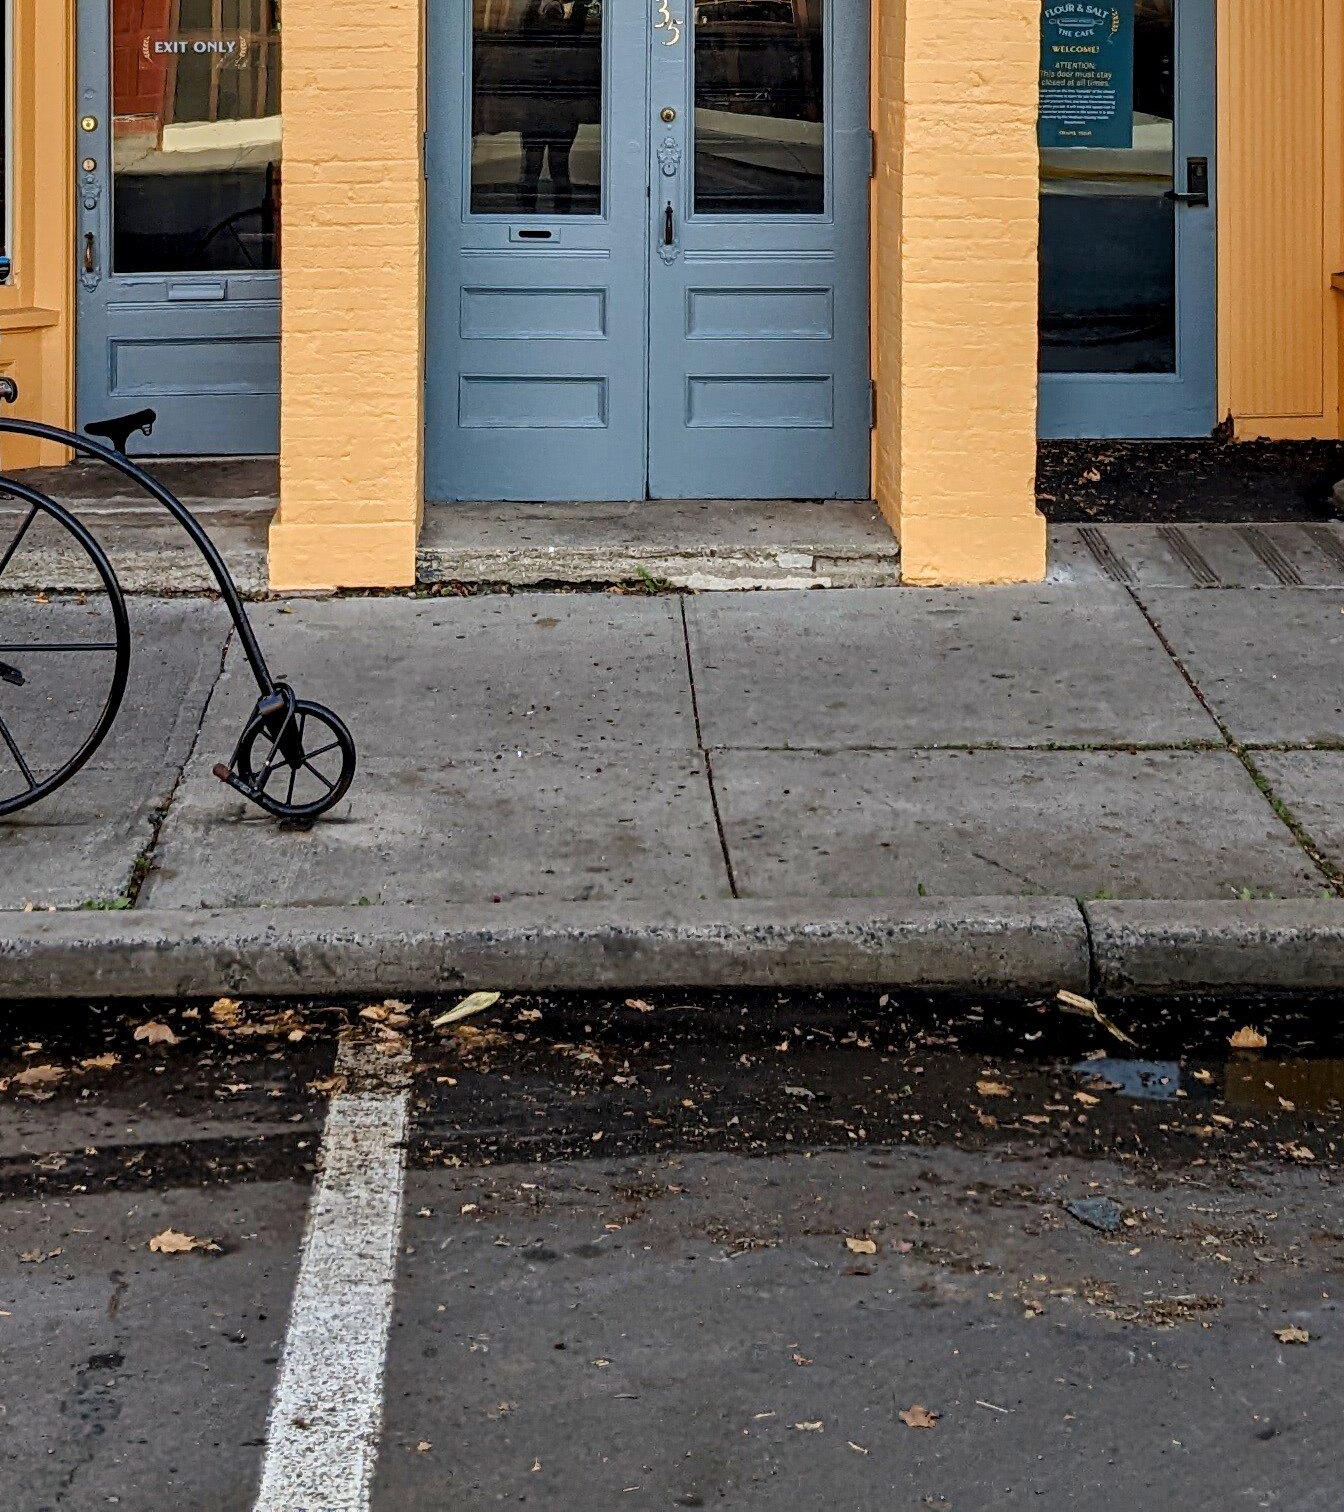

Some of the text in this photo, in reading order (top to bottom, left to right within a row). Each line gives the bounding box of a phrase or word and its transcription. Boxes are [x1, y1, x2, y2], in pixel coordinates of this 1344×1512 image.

[1044, 3, 1110, 18] FLOUR & SALT
[1058, 28, 1095, 38] THE CAFE
[154, 41, 236, 54] EXIT ONLY
